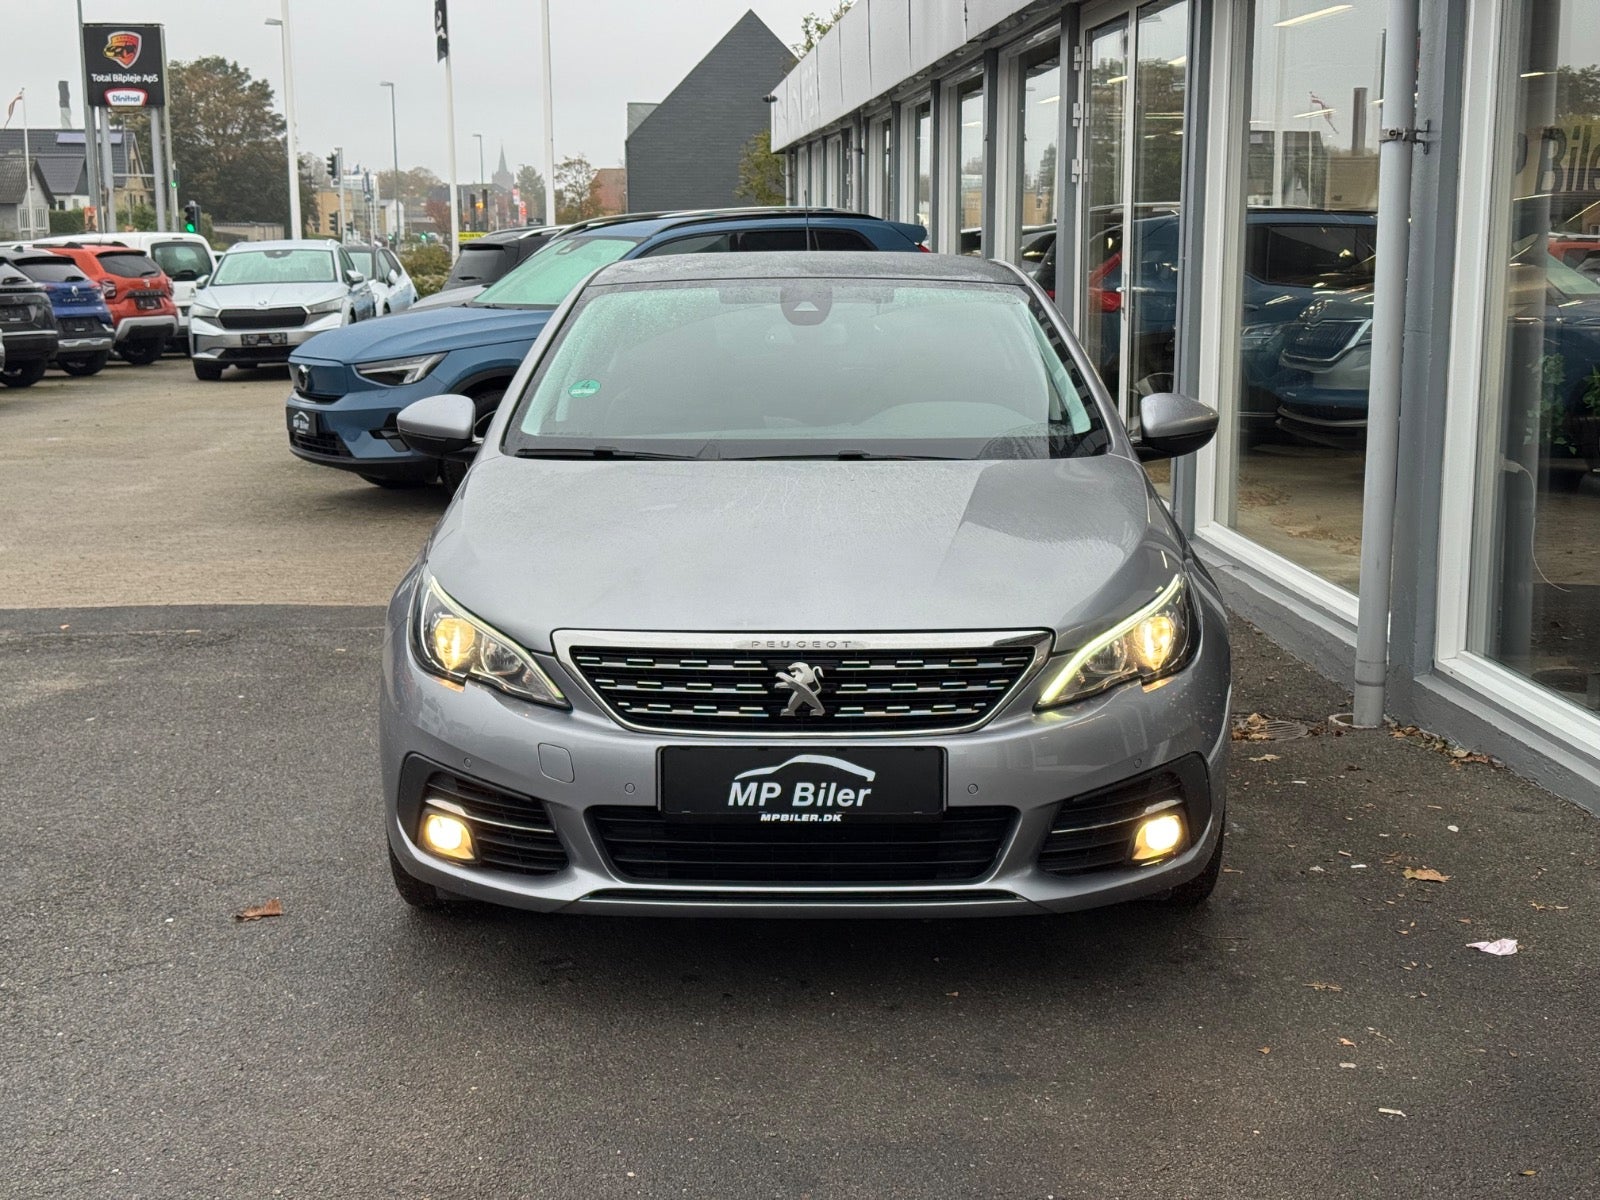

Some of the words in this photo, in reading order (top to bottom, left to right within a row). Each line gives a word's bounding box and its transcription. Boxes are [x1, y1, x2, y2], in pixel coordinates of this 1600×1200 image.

[91, 73, 111, 82] Total
[112, 73, 142, 84] Bilpleje
[142, 73, 159, 84] ApS
[112, 94, 140, 102] Dinitrol
[751, 640, 852, 649] PEUGEOT
[727, 782, 782, 807] MP
[791, 782, 872, 807] Biler
[760, 813, 843, 822] MPBILER.DK
